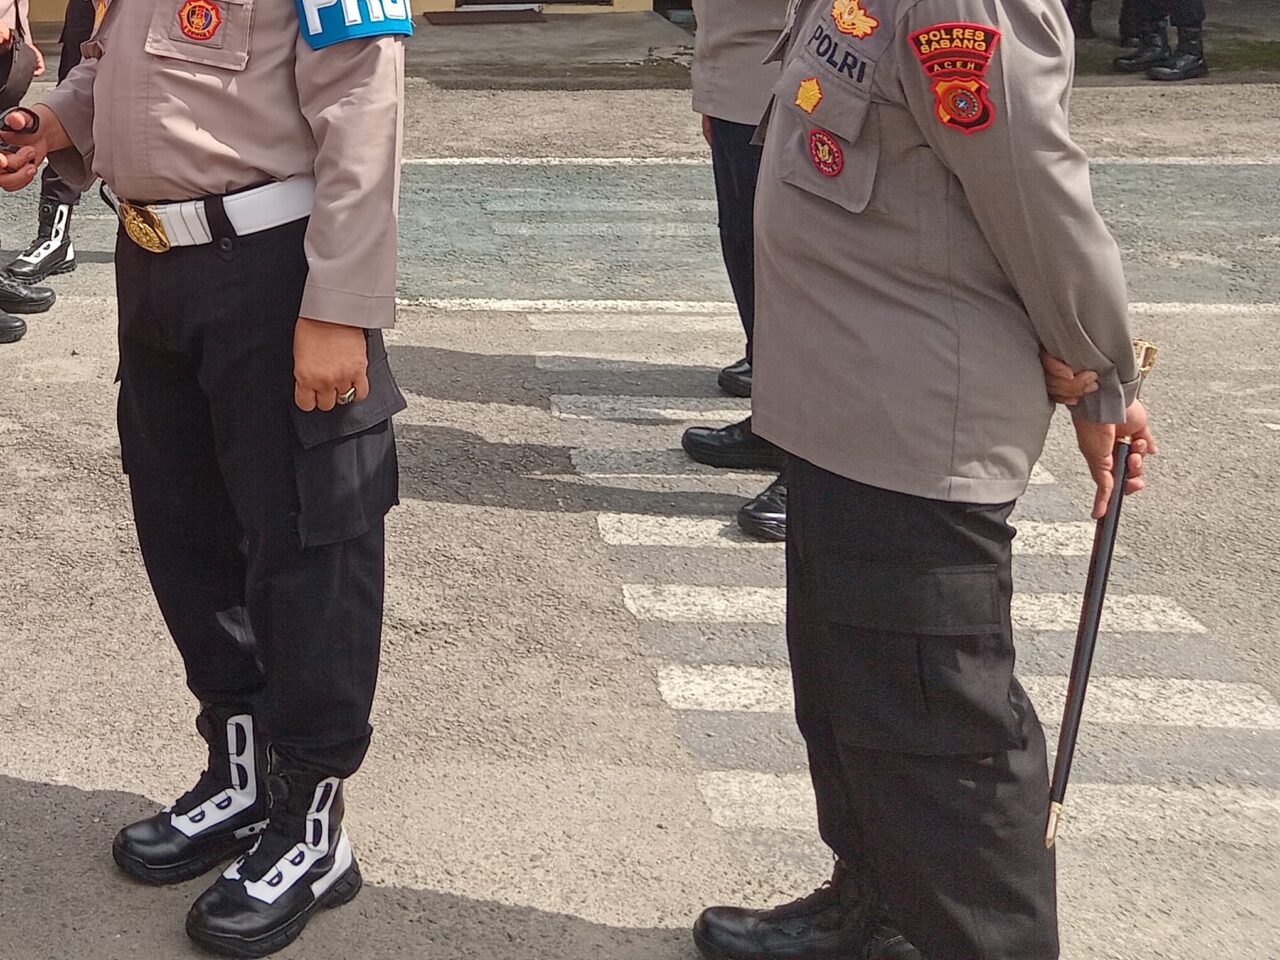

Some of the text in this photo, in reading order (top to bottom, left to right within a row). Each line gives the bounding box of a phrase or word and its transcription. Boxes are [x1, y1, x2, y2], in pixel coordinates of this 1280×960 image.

[919, 28, 985, 44] POLRES
[807, 24, 867, 83] POLRI
[920, 39, 986, 54] SABANG
[933, 61, 975, 73] ACEH
